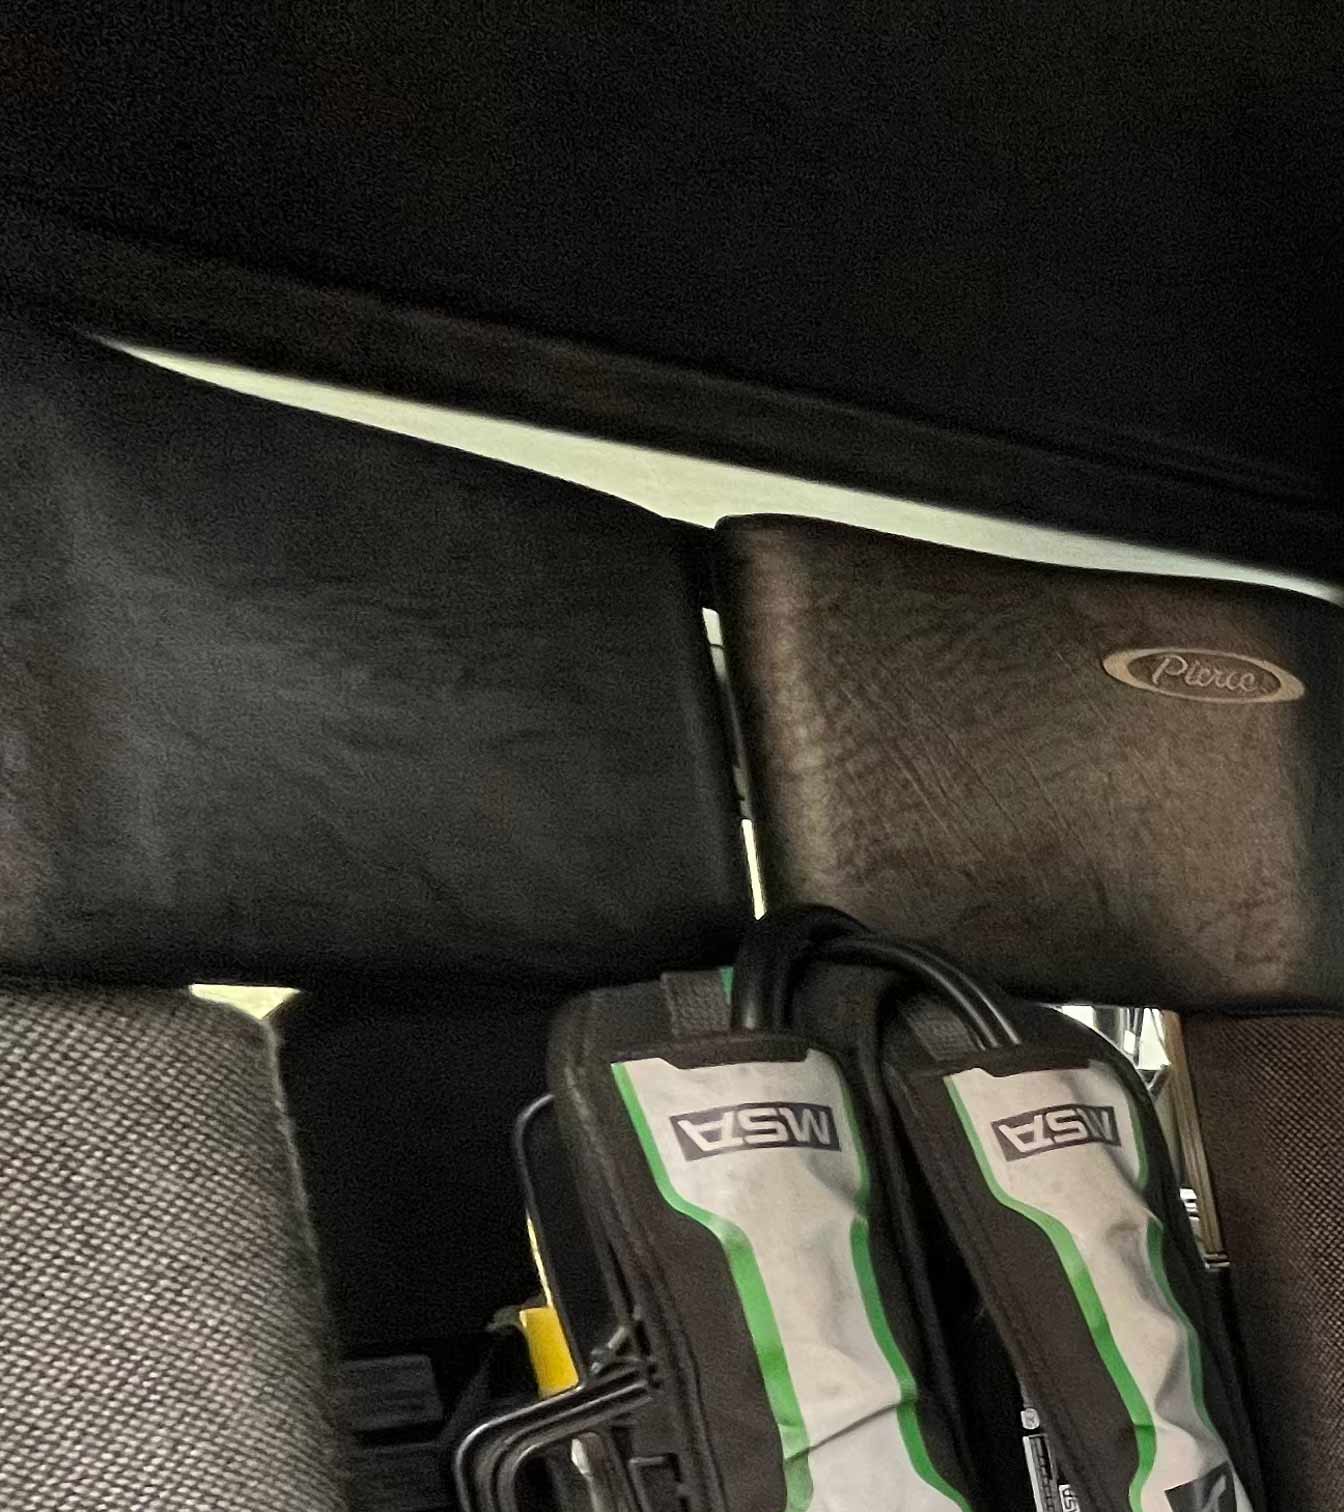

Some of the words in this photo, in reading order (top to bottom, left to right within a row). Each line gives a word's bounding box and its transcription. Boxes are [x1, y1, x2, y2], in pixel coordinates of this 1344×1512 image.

[1152, 653, 1258, 692] Pierce
[677, 1107, 831, 1152] MSA
[998, 1107, 1114, 1153] MSA
